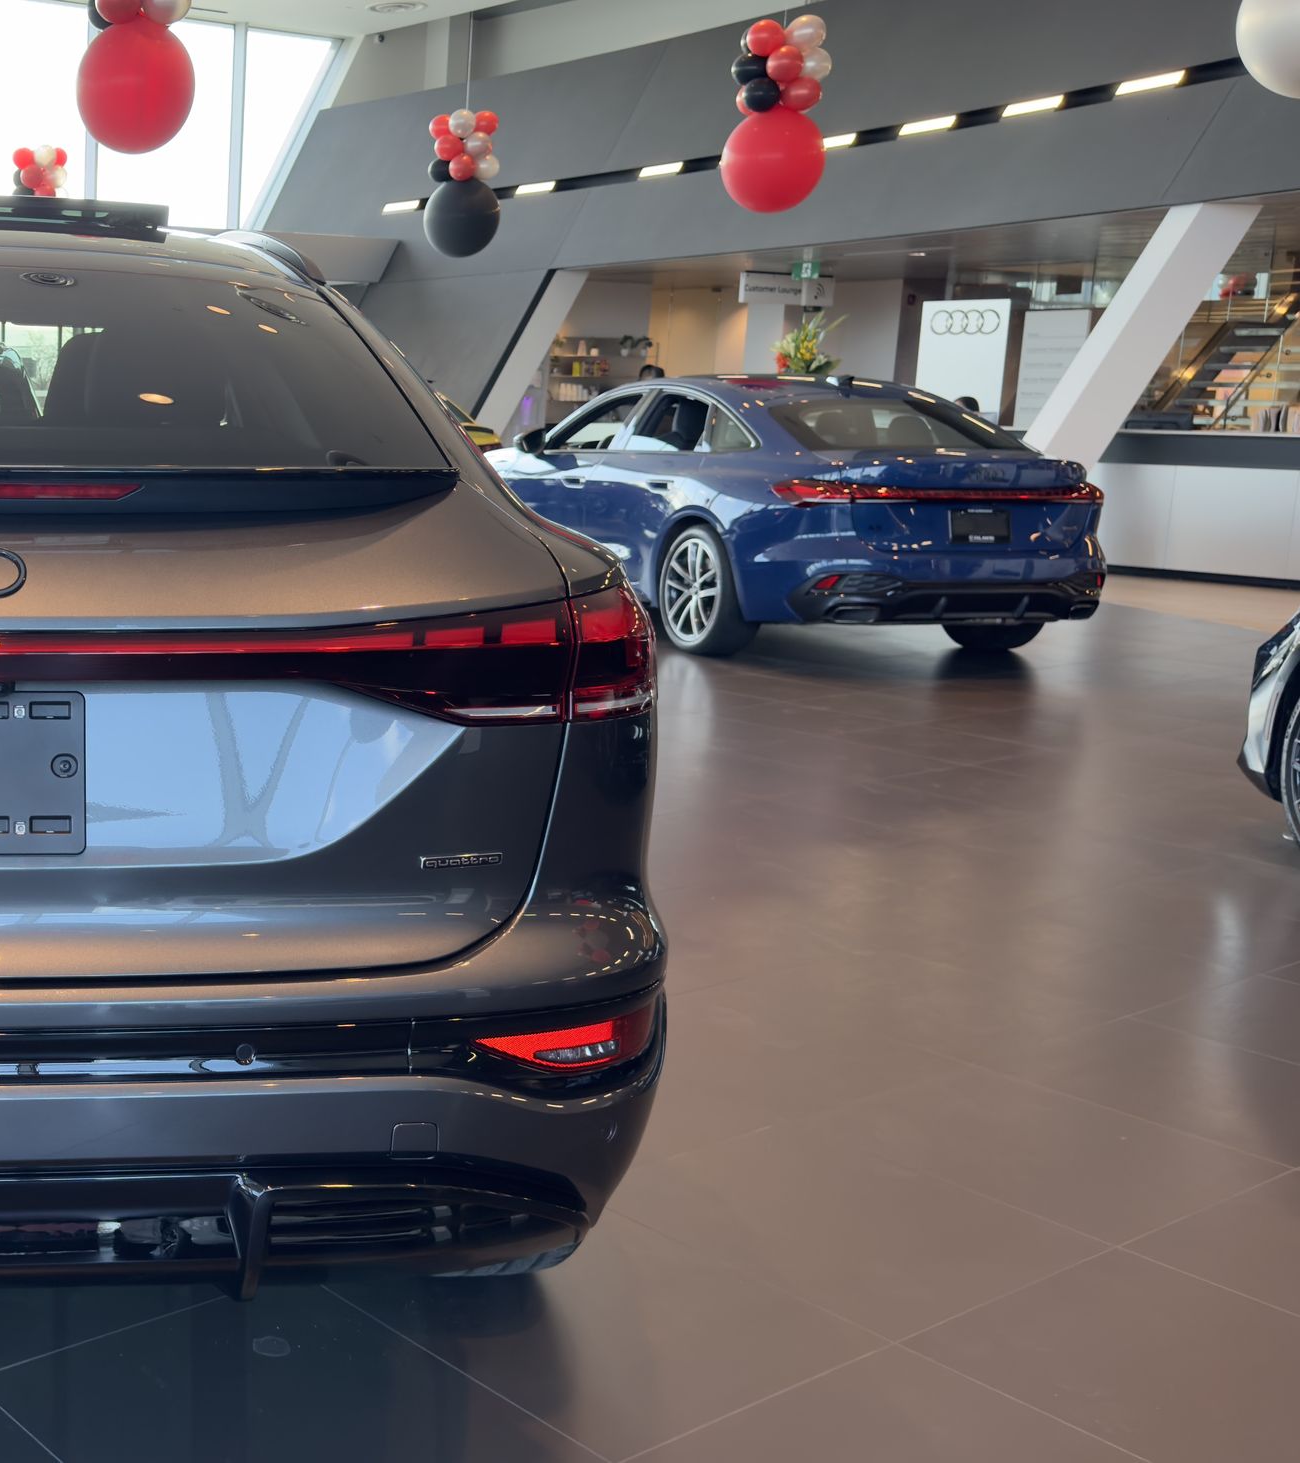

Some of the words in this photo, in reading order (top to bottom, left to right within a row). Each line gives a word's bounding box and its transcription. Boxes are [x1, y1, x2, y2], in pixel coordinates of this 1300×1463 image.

[744, 284, 777, 294] Customer
[778, 286, 802, 296] Lounge
[423, 855, 501, 869] quattro
